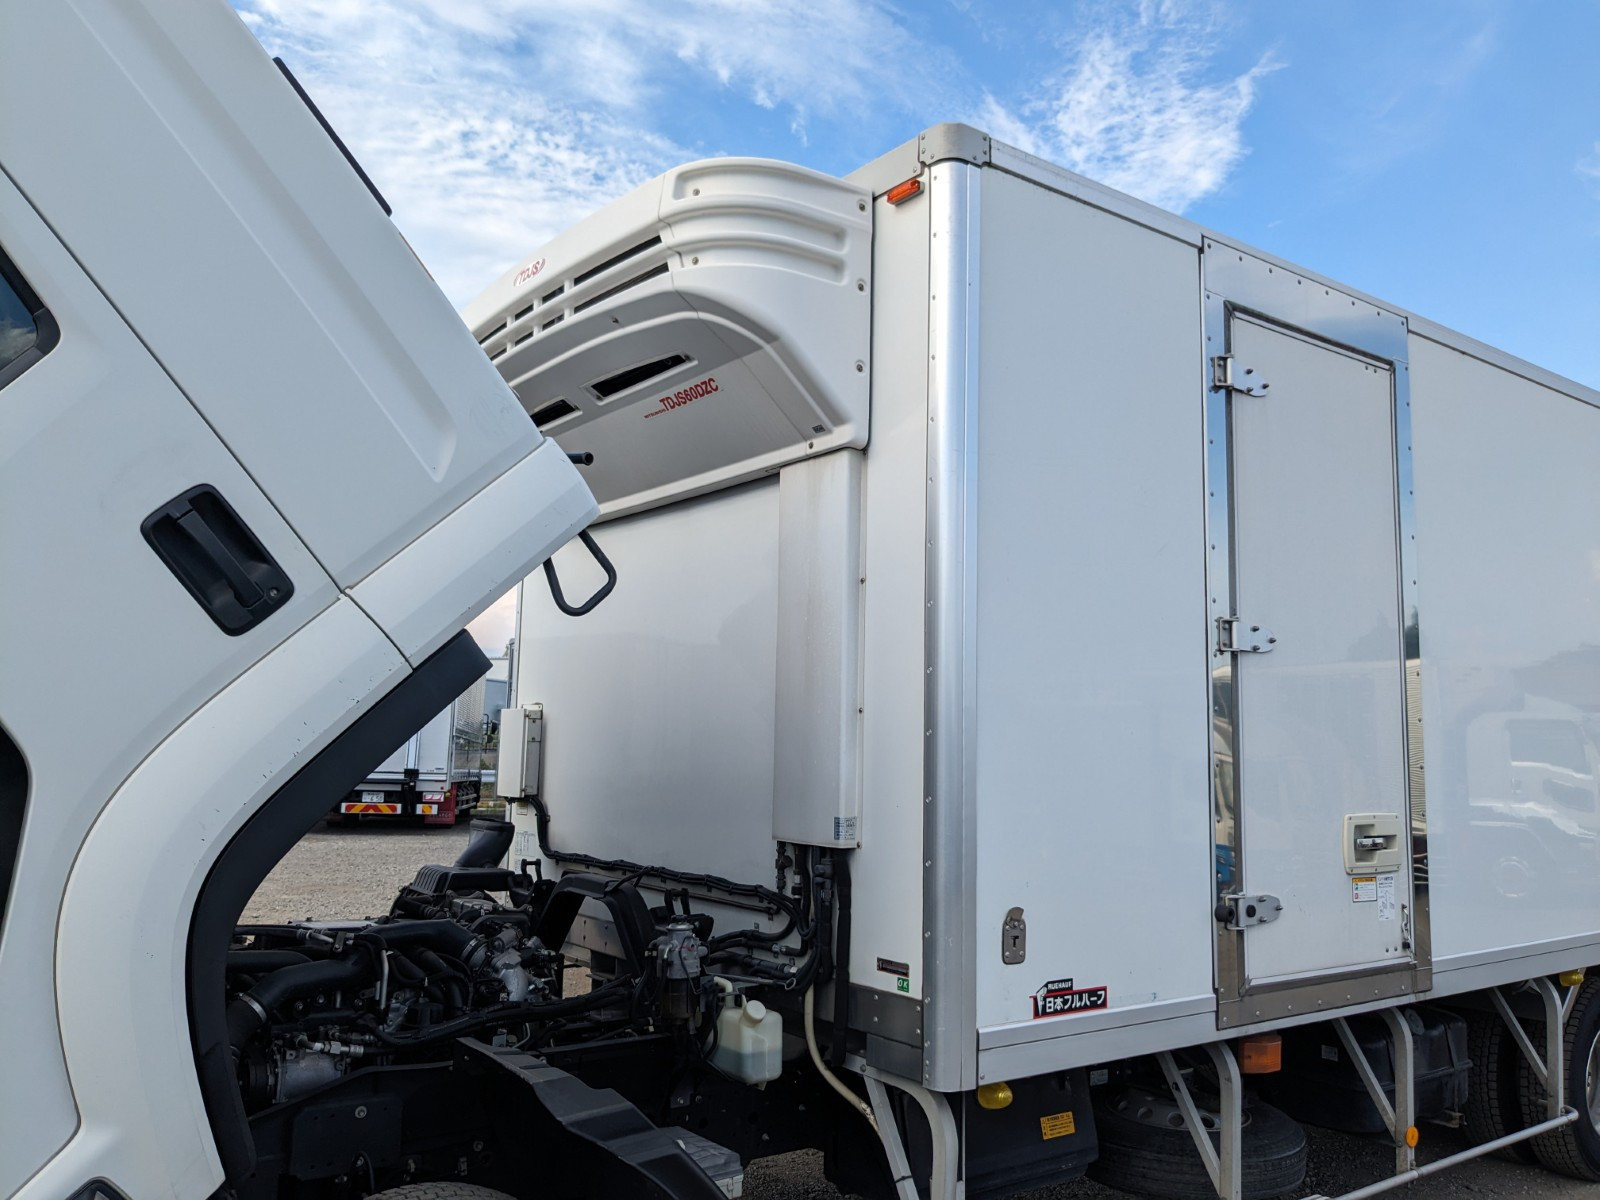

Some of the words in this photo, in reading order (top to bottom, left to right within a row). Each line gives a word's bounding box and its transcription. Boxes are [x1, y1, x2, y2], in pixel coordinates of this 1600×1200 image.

[659, 377, 719, 411] TDJS60DZC
[898, 979, 909, 989] OK
[1046, 990, 1105, 1012] 日本フルハーフ
